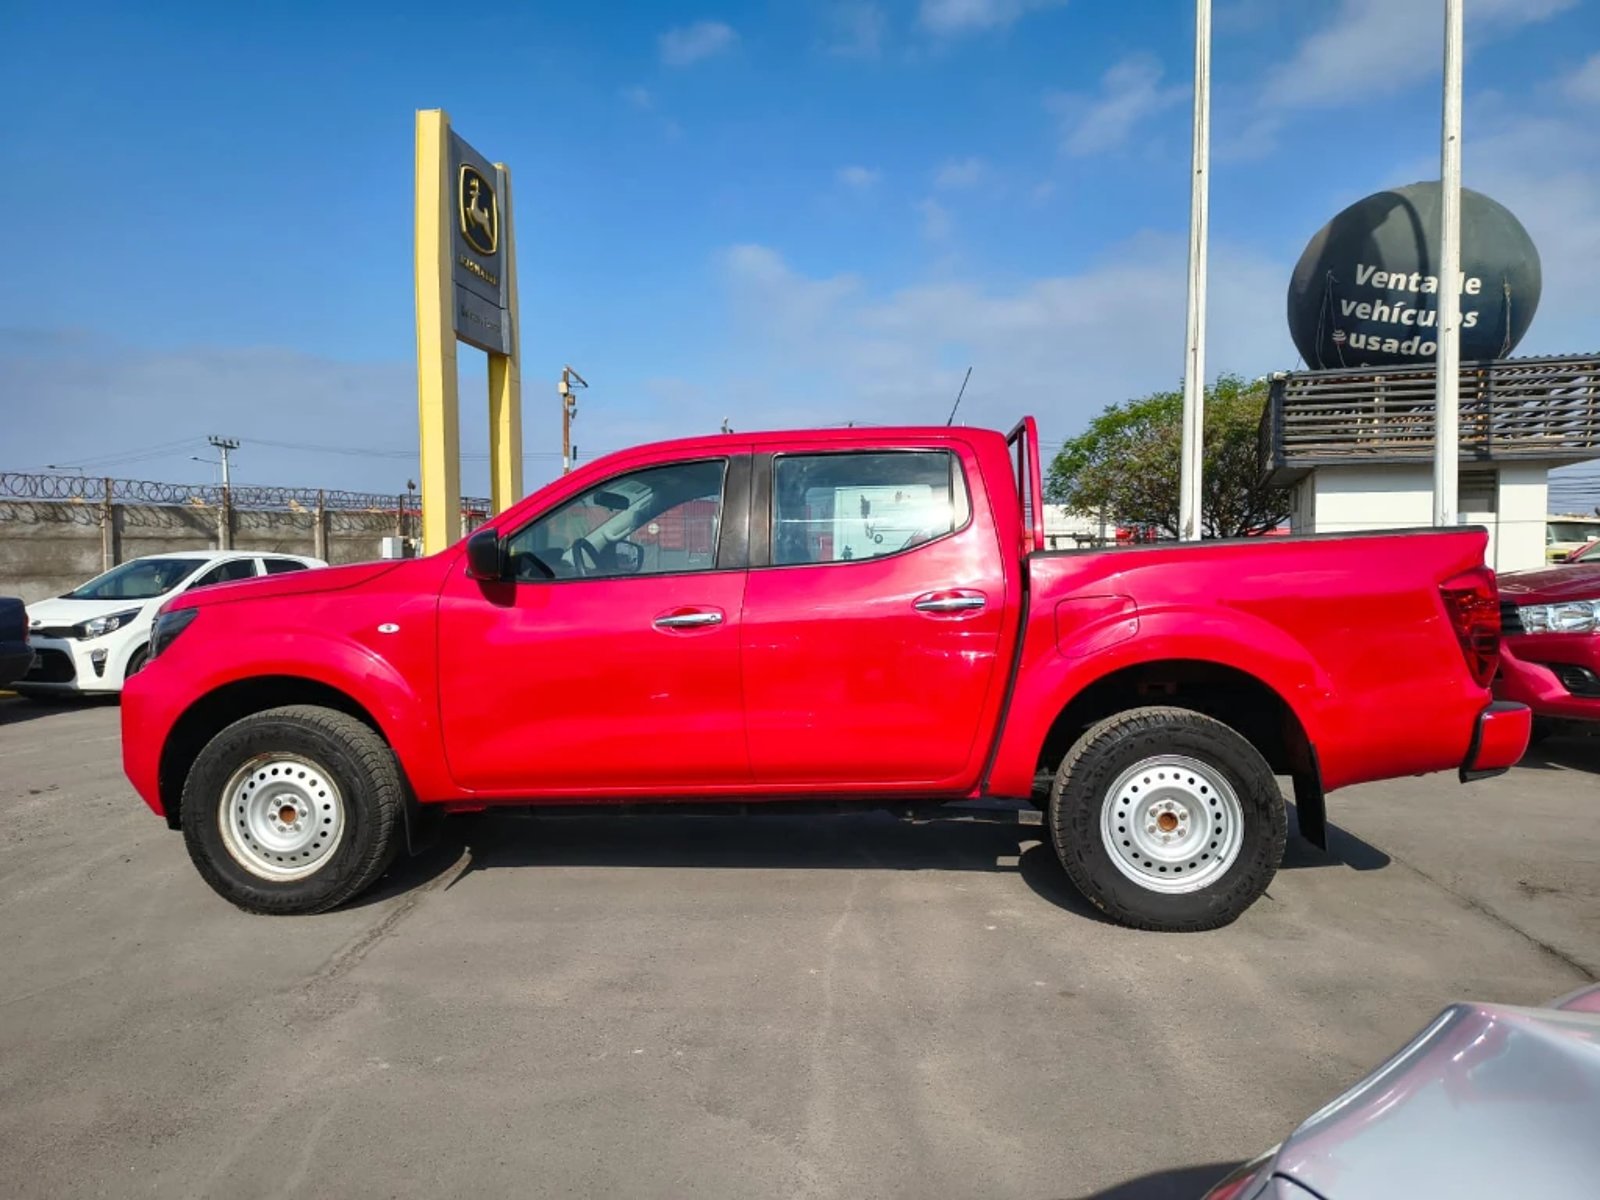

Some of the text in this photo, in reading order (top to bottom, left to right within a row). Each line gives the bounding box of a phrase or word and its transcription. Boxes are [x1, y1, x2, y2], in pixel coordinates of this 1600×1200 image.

[1355, 263, 1438, 294] Venta
[1340, 299, 1479, 328] vehícus
[1349, 332, 1438, 356] usado
